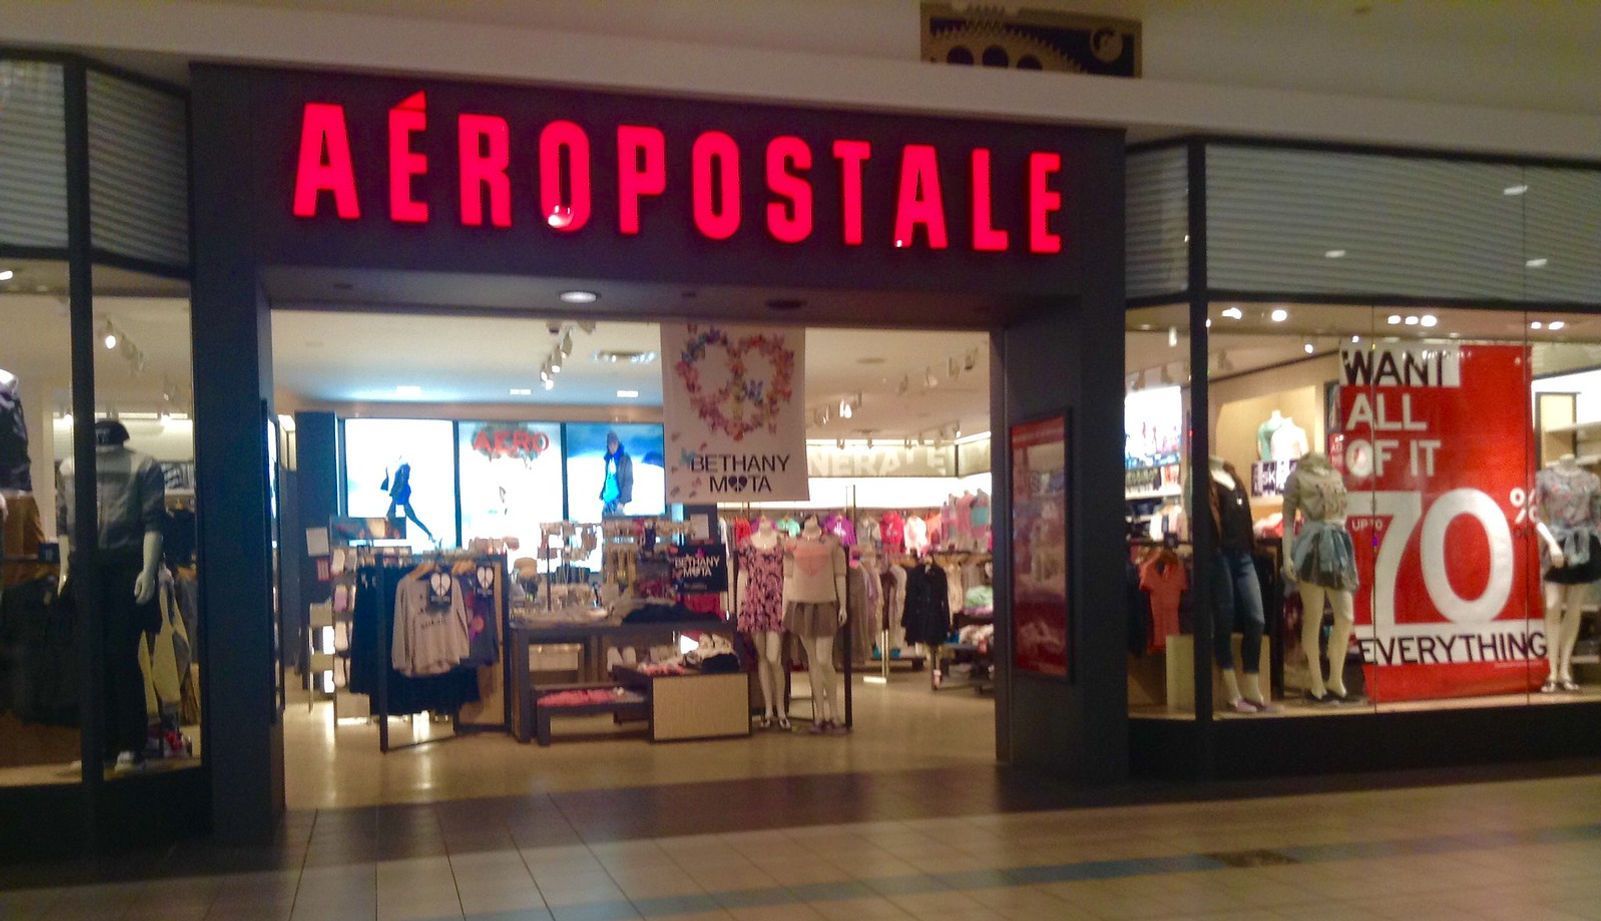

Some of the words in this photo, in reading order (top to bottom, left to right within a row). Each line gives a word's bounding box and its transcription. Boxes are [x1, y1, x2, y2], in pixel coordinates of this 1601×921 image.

[293, 90, 1062, 254] AÉROPOSTALE
[1342, 350, 1446, 386] WANT
[1346, 392, 1428, 431] ALL
[473, 431, 550, 453] AERO
[1345, 439, 1399, 478] OF
[1409, 438, 1442, 477] IT
[690, 453, 790, 472] BETHANY
[1351, 519, 1368, 532] UP
[674, 554, 720, 569] BETHANY
[1358, 632, 1548, 665] EVERYTHING
